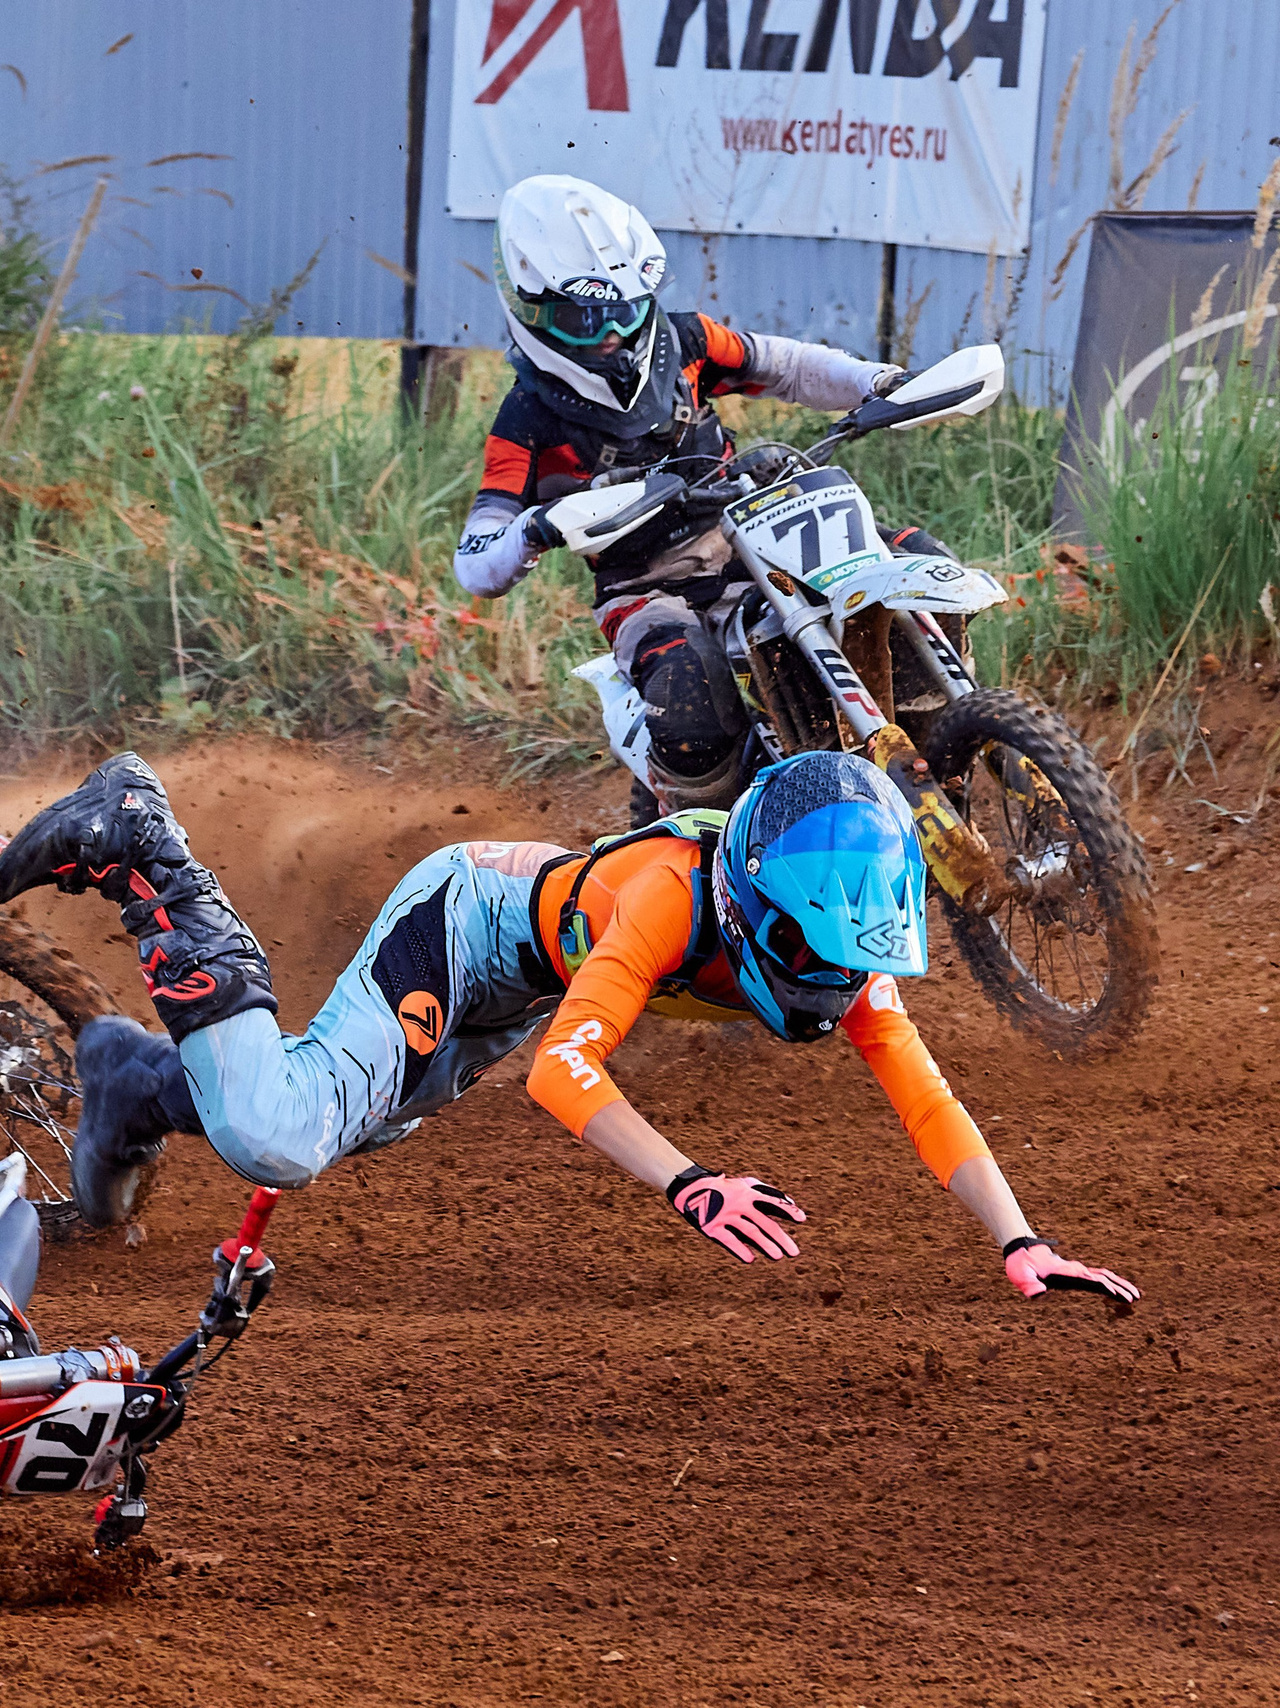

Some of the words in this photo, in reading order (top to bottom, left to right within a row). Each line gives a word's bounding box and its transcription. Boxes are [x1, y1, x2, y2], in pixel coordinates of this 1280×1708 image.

[565, 279, 619, 300] Airoh
[744, 495, 817, 534] NABOKOV
[824, 487, 857, 499] IVAN
[771, 499, 867, 577] 77
[15, 1412, 110, 1492] 70
